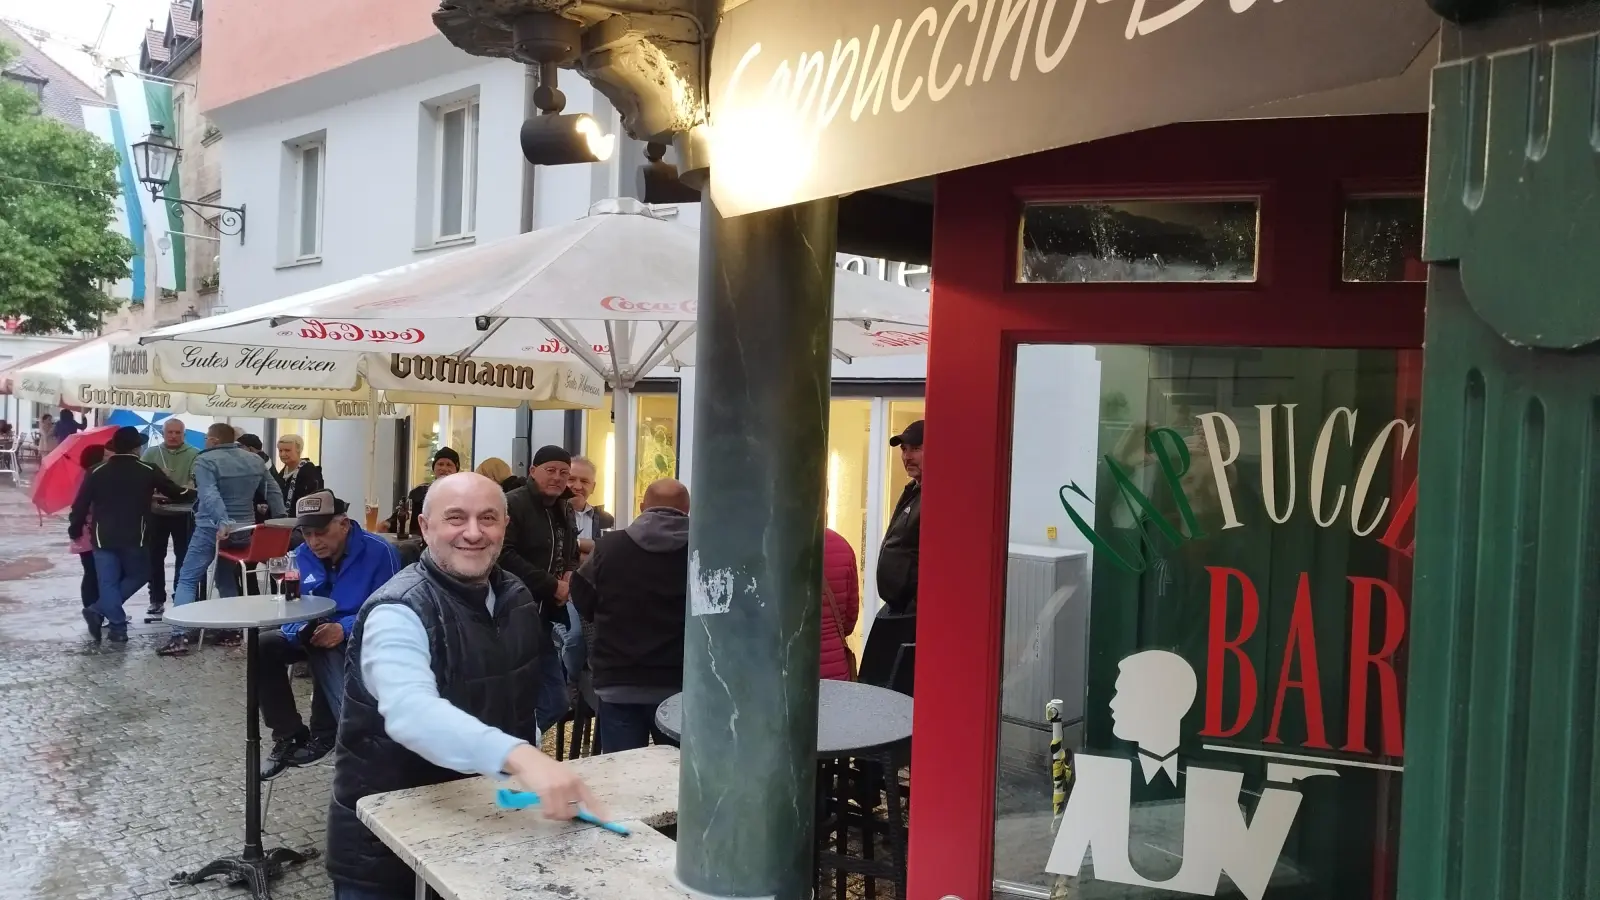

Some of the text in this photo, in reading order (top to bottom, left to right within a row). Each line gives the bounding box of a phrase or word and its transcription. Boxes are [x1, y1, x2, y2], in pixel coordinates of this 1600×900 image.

[181, 346, 337, 376] Gutes Hefeweizen
[390, 353, 535, 390] Gutmann
[78, 384, 172, 409] Gutmann
[206, 395, 307, 412] Gutes Hefeweizen
[1199, 566, 1405, 757] BAR
